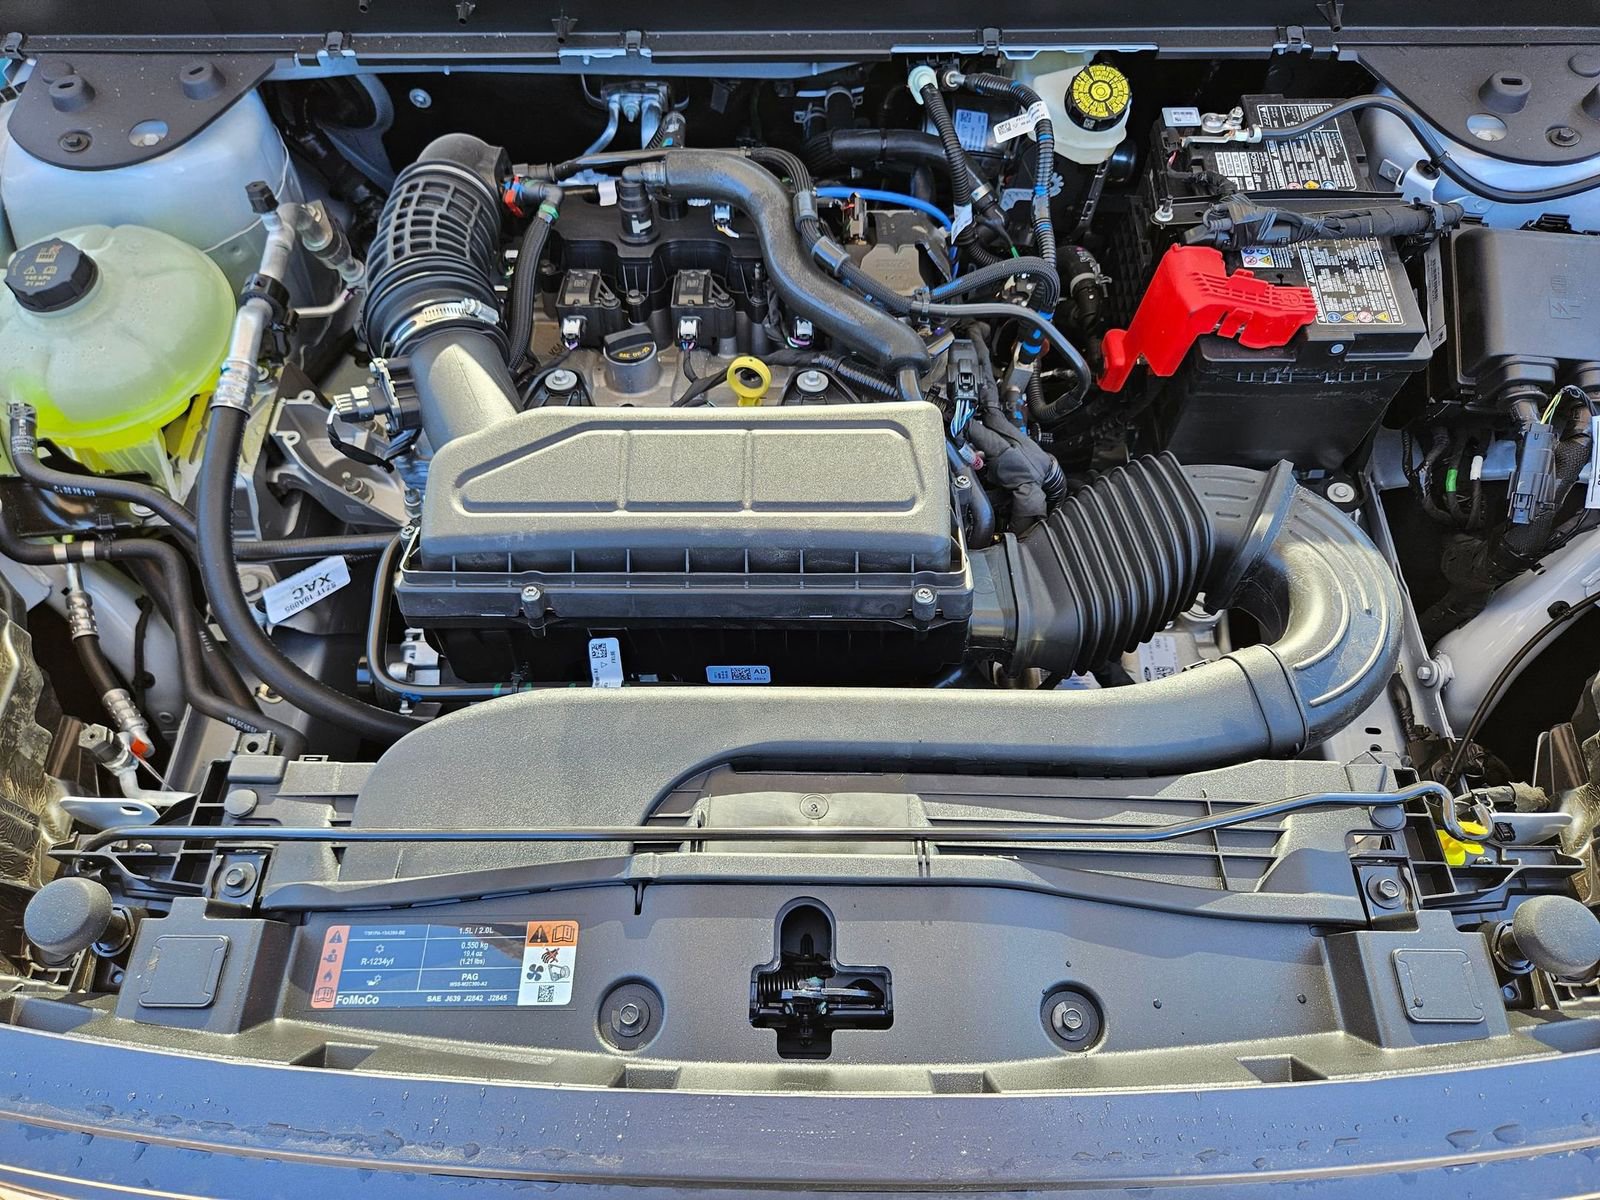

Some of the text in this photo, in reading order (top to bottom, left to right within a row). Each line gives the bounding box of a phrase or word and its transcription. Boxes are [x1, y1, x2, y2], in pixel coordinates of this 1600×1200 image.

[292, 573, 331, 599] XAC
[461, 941, 488, 950] 0.550 kg
[360, 957, 395, 967] R-1234yf
[461, 973, 479, 981] PAG
[335, 994, 380, 1005] FoMoCo
[463, 994, 484, 1002] J2842
